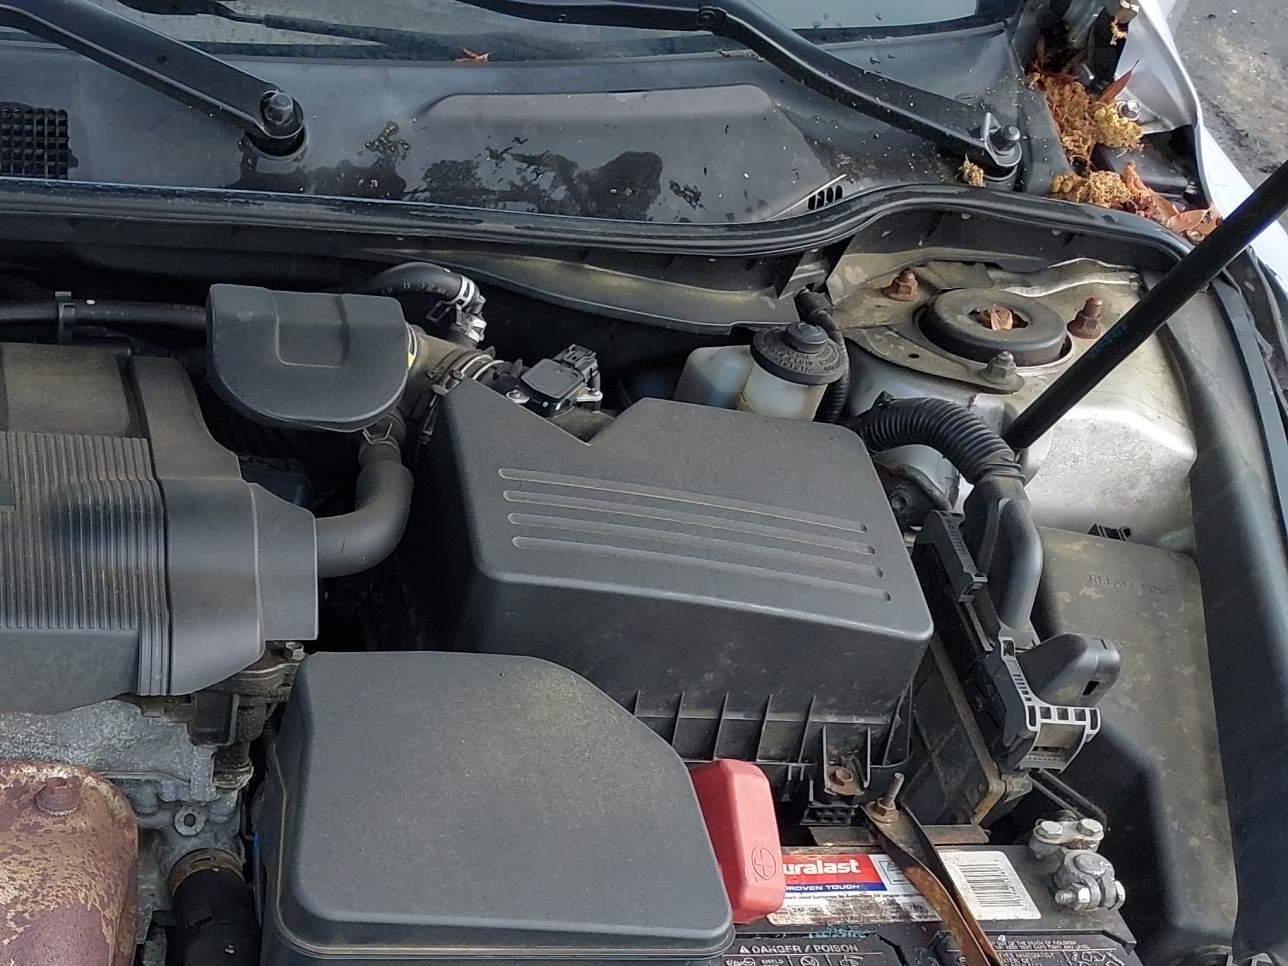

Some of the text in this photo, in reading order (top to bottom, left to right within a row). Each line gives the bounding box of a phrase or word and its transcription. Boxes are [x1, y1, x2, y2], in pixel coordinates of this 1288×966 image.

[783, 859, 861, 876] uralast
[752, 945, 802, 953] DANGER
[813, 945, 859, 953] POISON
